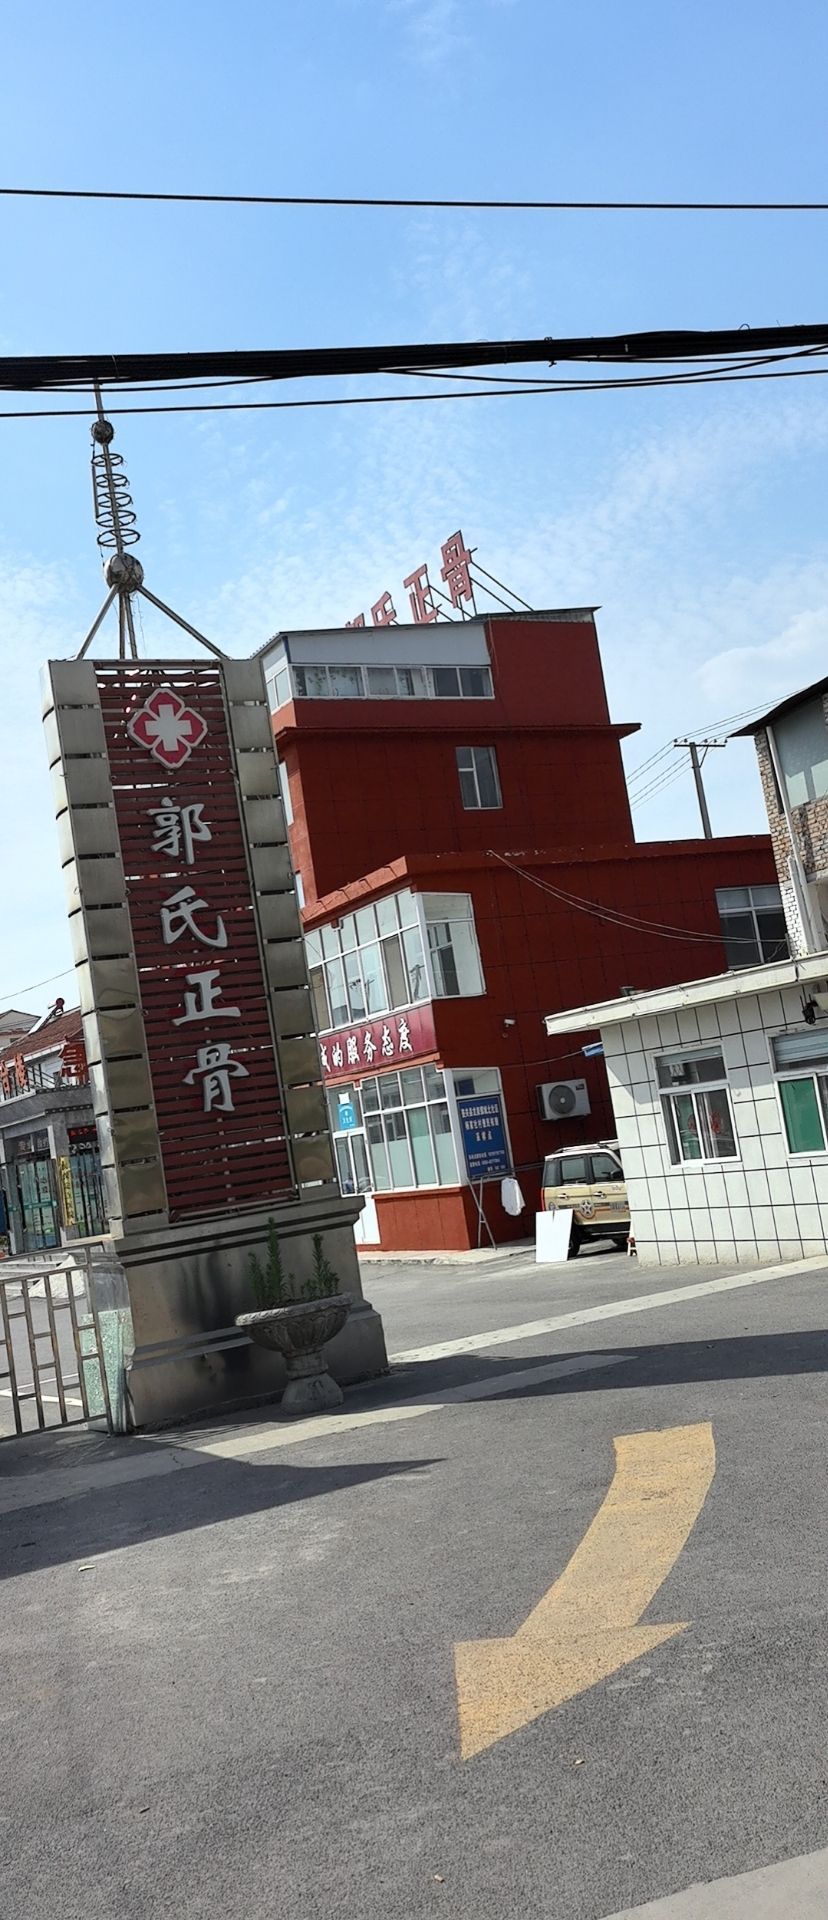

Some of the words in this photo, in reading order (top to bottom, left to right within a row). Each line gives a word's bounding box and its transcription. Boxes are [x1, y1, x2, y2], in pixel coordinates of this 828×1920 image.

[345, 530, 472, 628] 氏正骨
[147, 797, 250, 1113] 郭氏正骨
